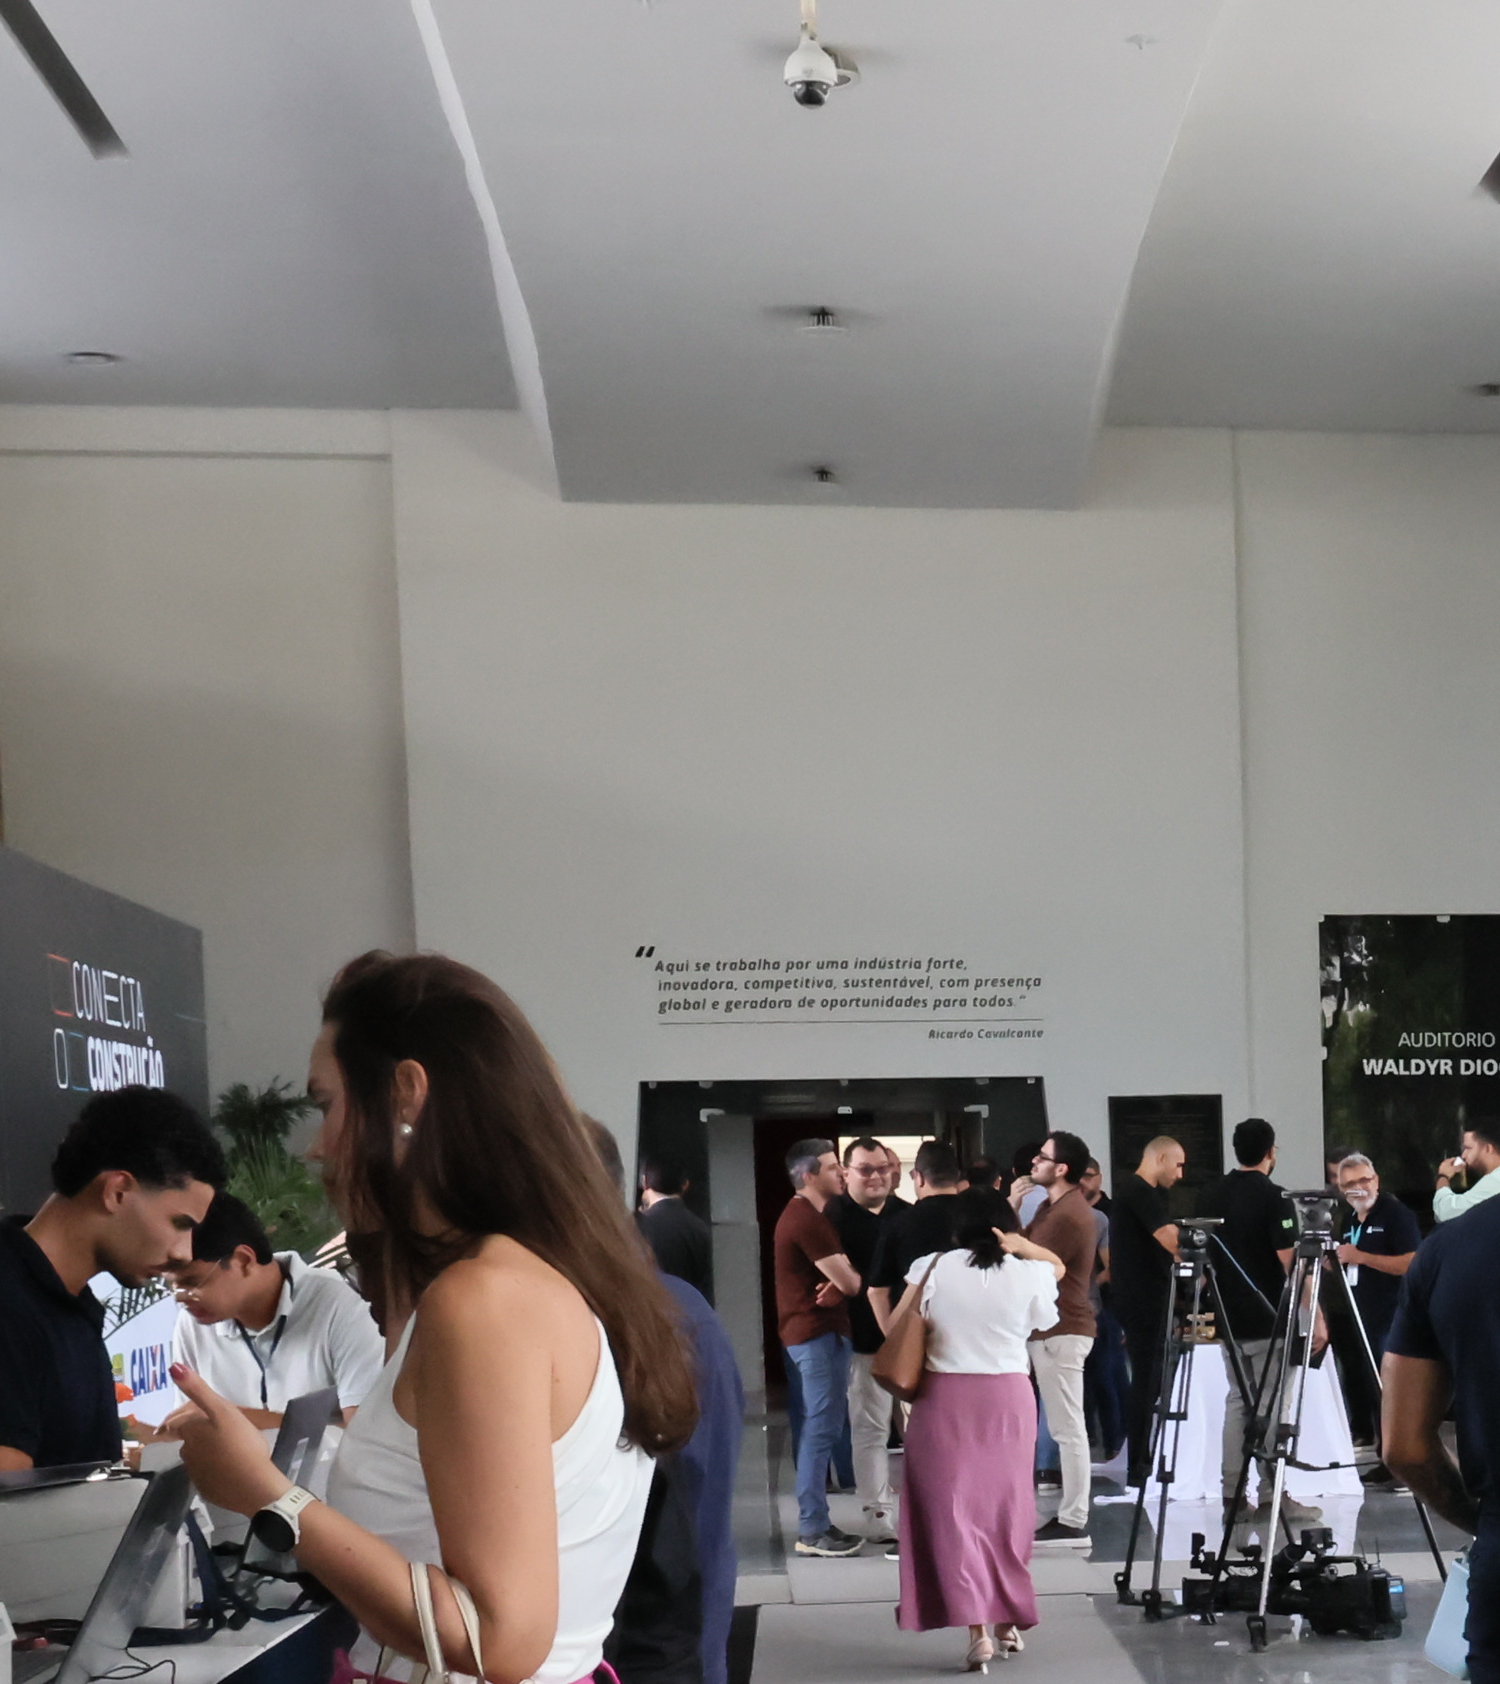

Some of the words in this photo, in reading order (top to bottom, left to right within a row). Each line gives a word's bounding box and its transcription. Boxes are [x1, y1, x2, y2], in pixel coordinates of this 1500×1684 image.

[695, 961, 710, 972] se
[716, 958, 780, 972] trabalha
[785, 960, 811, 973] por
[816, 960, 848, 971] uma
[854, 957, 921, 970] indústria
[926, 957, 967, 973] forte,
[658, 978, 738, 992] inovadora,
[744, 976, 836, 992] competitiva,
[843, 976, 933, 990] sustentável,
[940, 978, 969, 989] com
[974, 977, 1041, 991] presença
[73, 961, 146, 1032] CONECTA
[658, 998, 706, 1014] global
[712, 1000, 720, 1010] e
[724, 997, 792, 1013] geradora
[798, 996, 815, 1009] de
[821, 995, 927, 1011] oportunidades
[933, 998, 967, 1011] para
[929, 1029, 973, 1039] Ricardo
[978, 1028, 1043, 1039] Cavalcante
[1398, 1032, 1496, 1048] AUDITORIO
[1362, 1059, 1453, 1075] WALDYR
[131, 1343, 167, 1397] CAIXA
